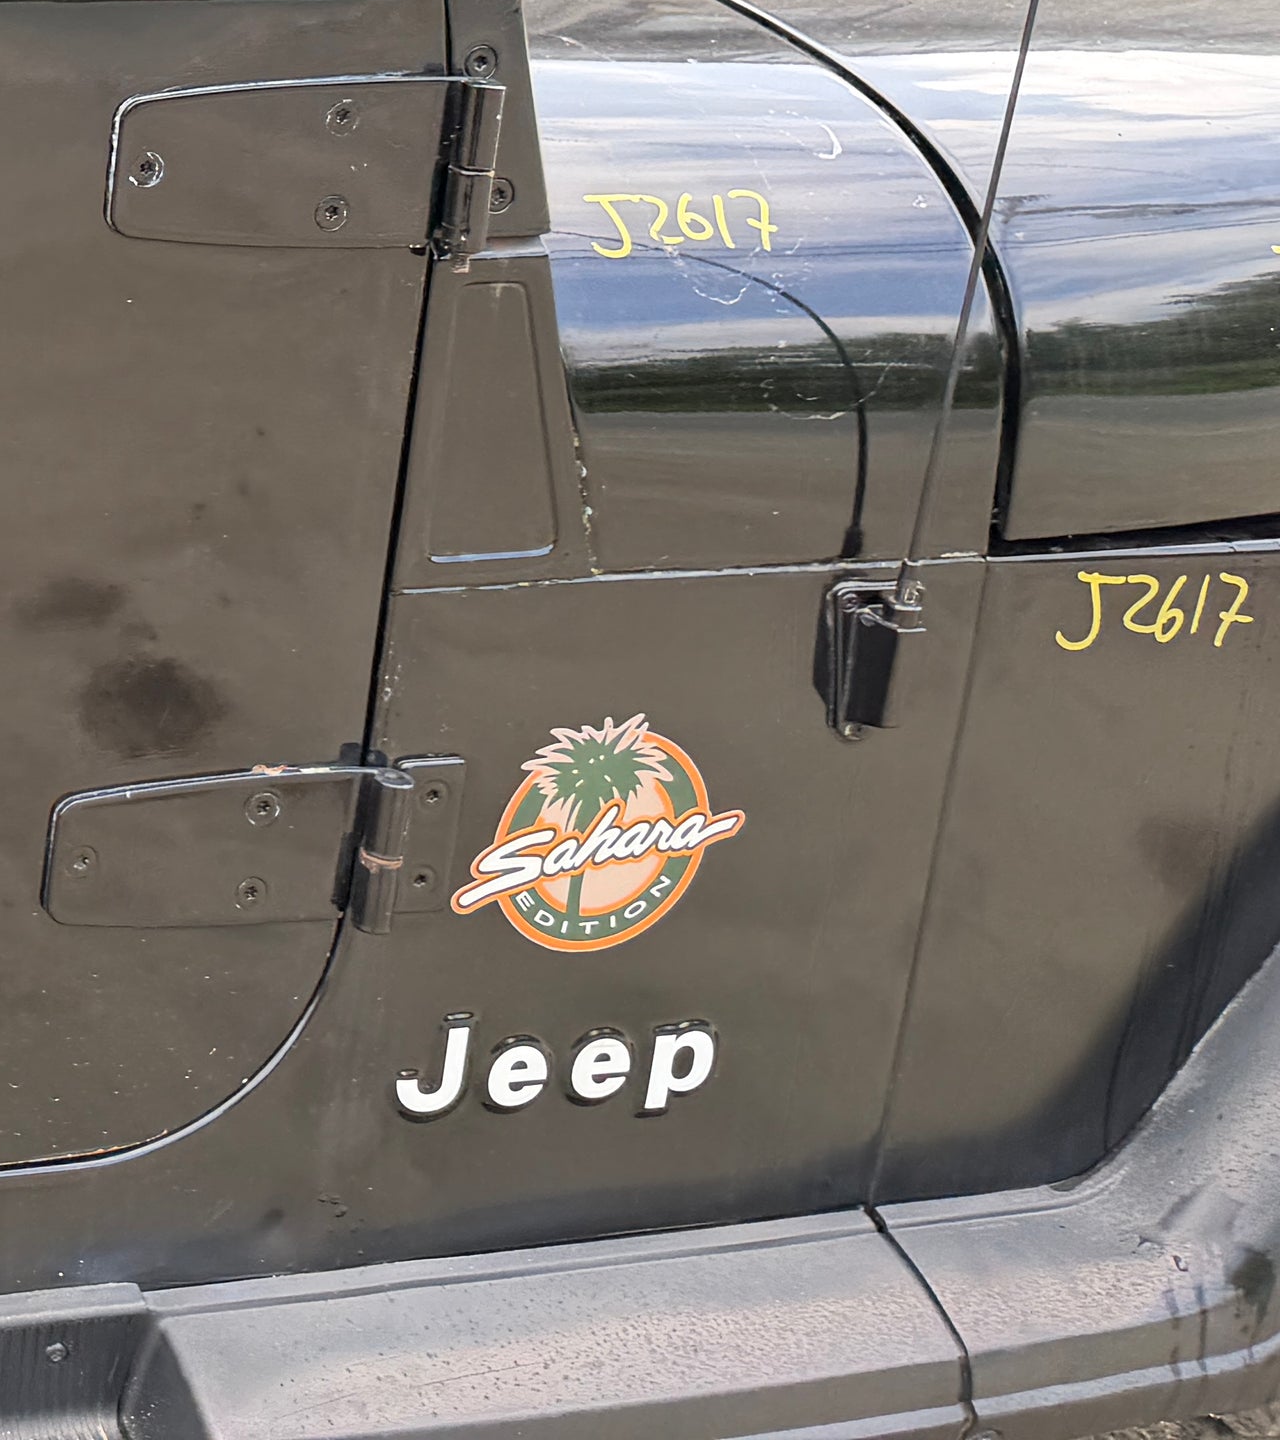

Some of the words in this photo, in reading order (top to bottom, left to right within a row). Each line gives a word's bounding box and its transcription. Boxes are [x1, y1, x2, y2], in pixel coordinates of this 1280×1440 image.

[582, 188, 779, 259] J2617
[1055, 571, 1255, 653] J2617
[457, 803, 742, 910] Sahara
[515, 874, 675, 936] EDITION
[394, 1017, 717, 1121] Jeep
